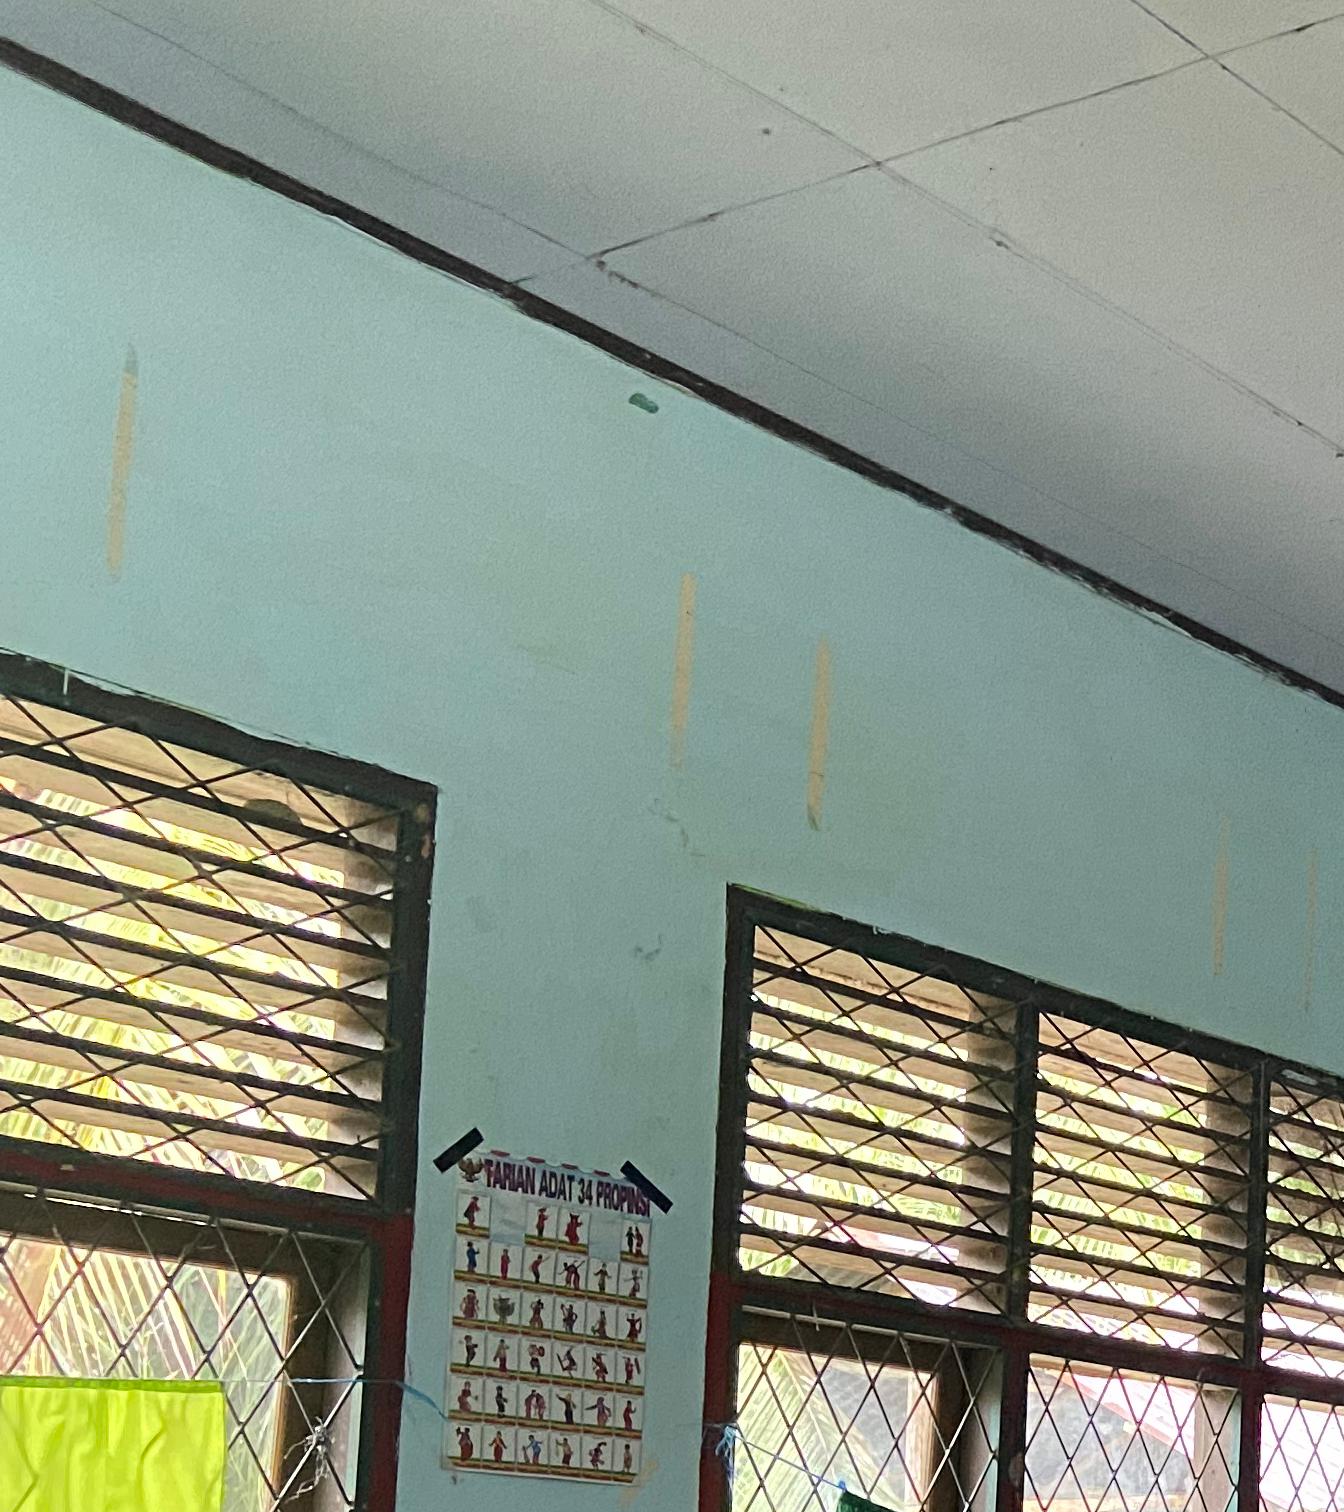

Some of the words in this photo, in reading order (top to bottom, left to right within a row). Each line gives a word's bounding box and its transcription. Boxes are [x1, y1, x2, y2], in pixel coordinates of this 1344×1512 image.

[484, 1158, 536, 1195] TARIAN
[539, 1169, 575, 1202] ADAT
[578, 1177, 593, 1206] 34
